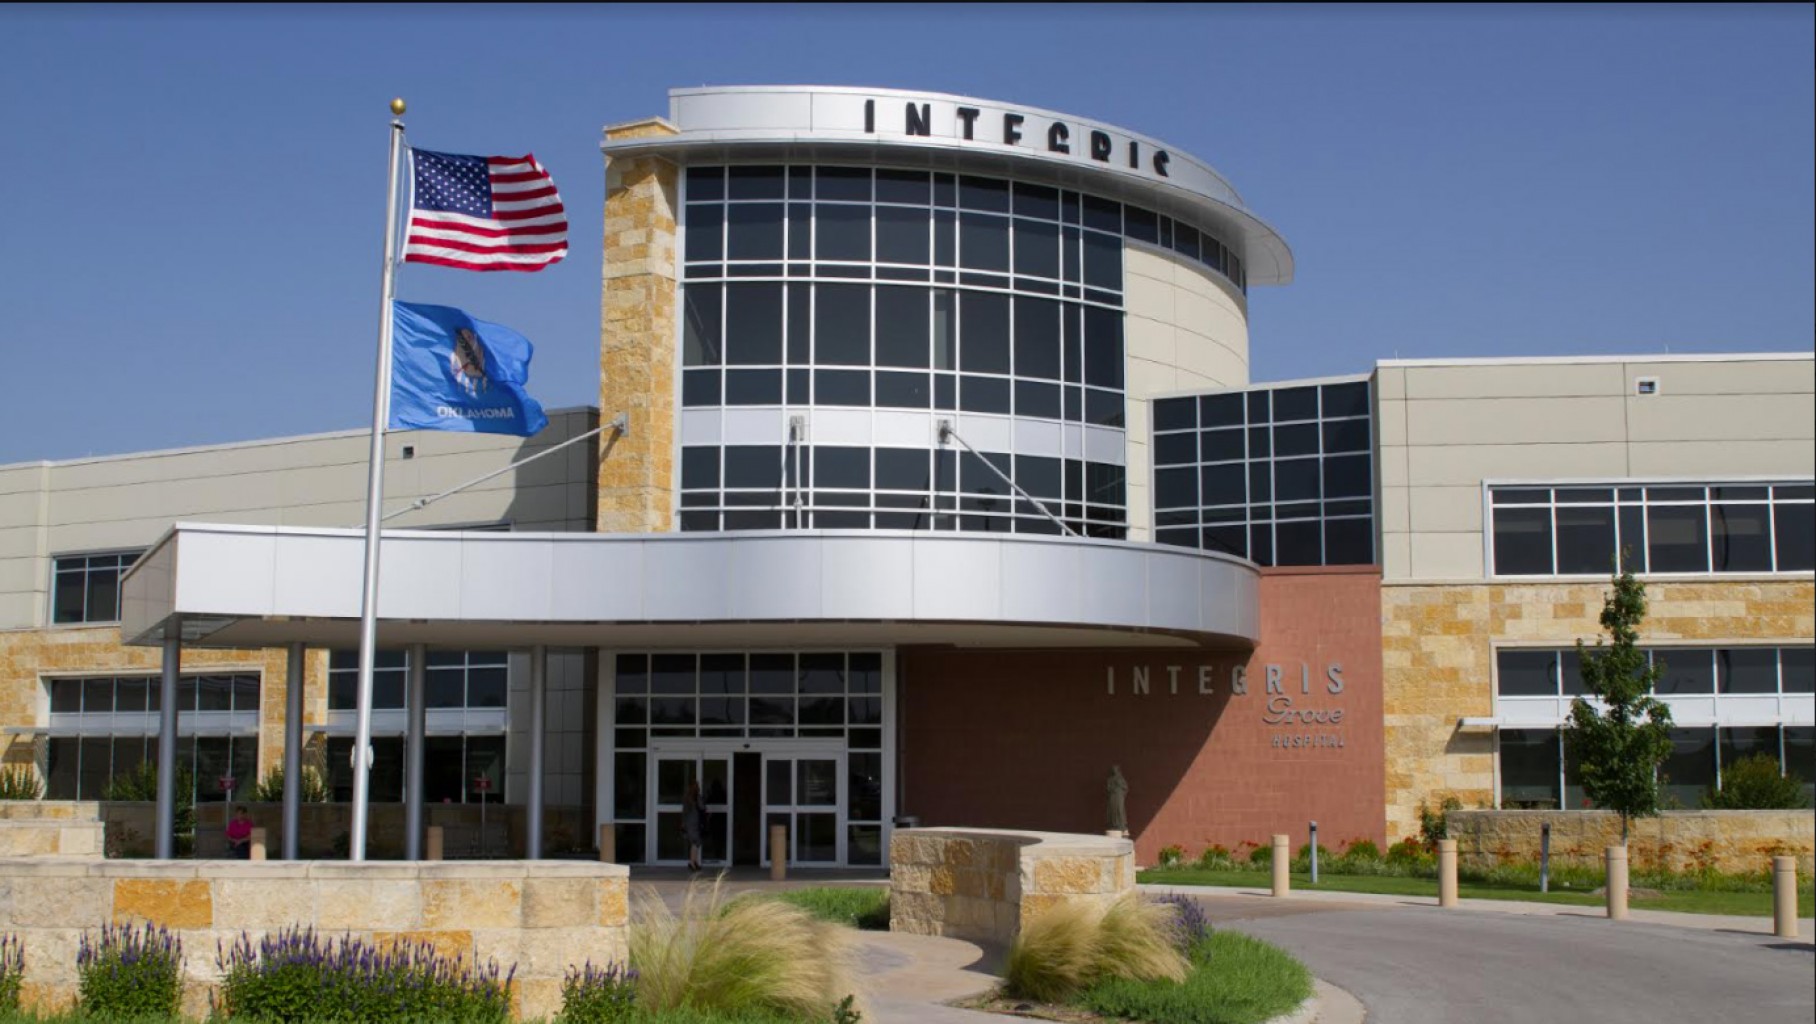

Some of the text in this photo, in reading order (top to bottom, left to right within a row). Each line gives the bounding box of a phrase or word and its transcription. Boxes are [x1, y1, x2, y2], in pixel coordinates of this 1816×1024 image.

[437, 405, 515, 419] OKLAHOMA
[1107, 664, 1344, 695] INTEGRIS
[1262, 697, 1343, 724] Grove
[1271, 733, 1345, 749] HOSPITAL
